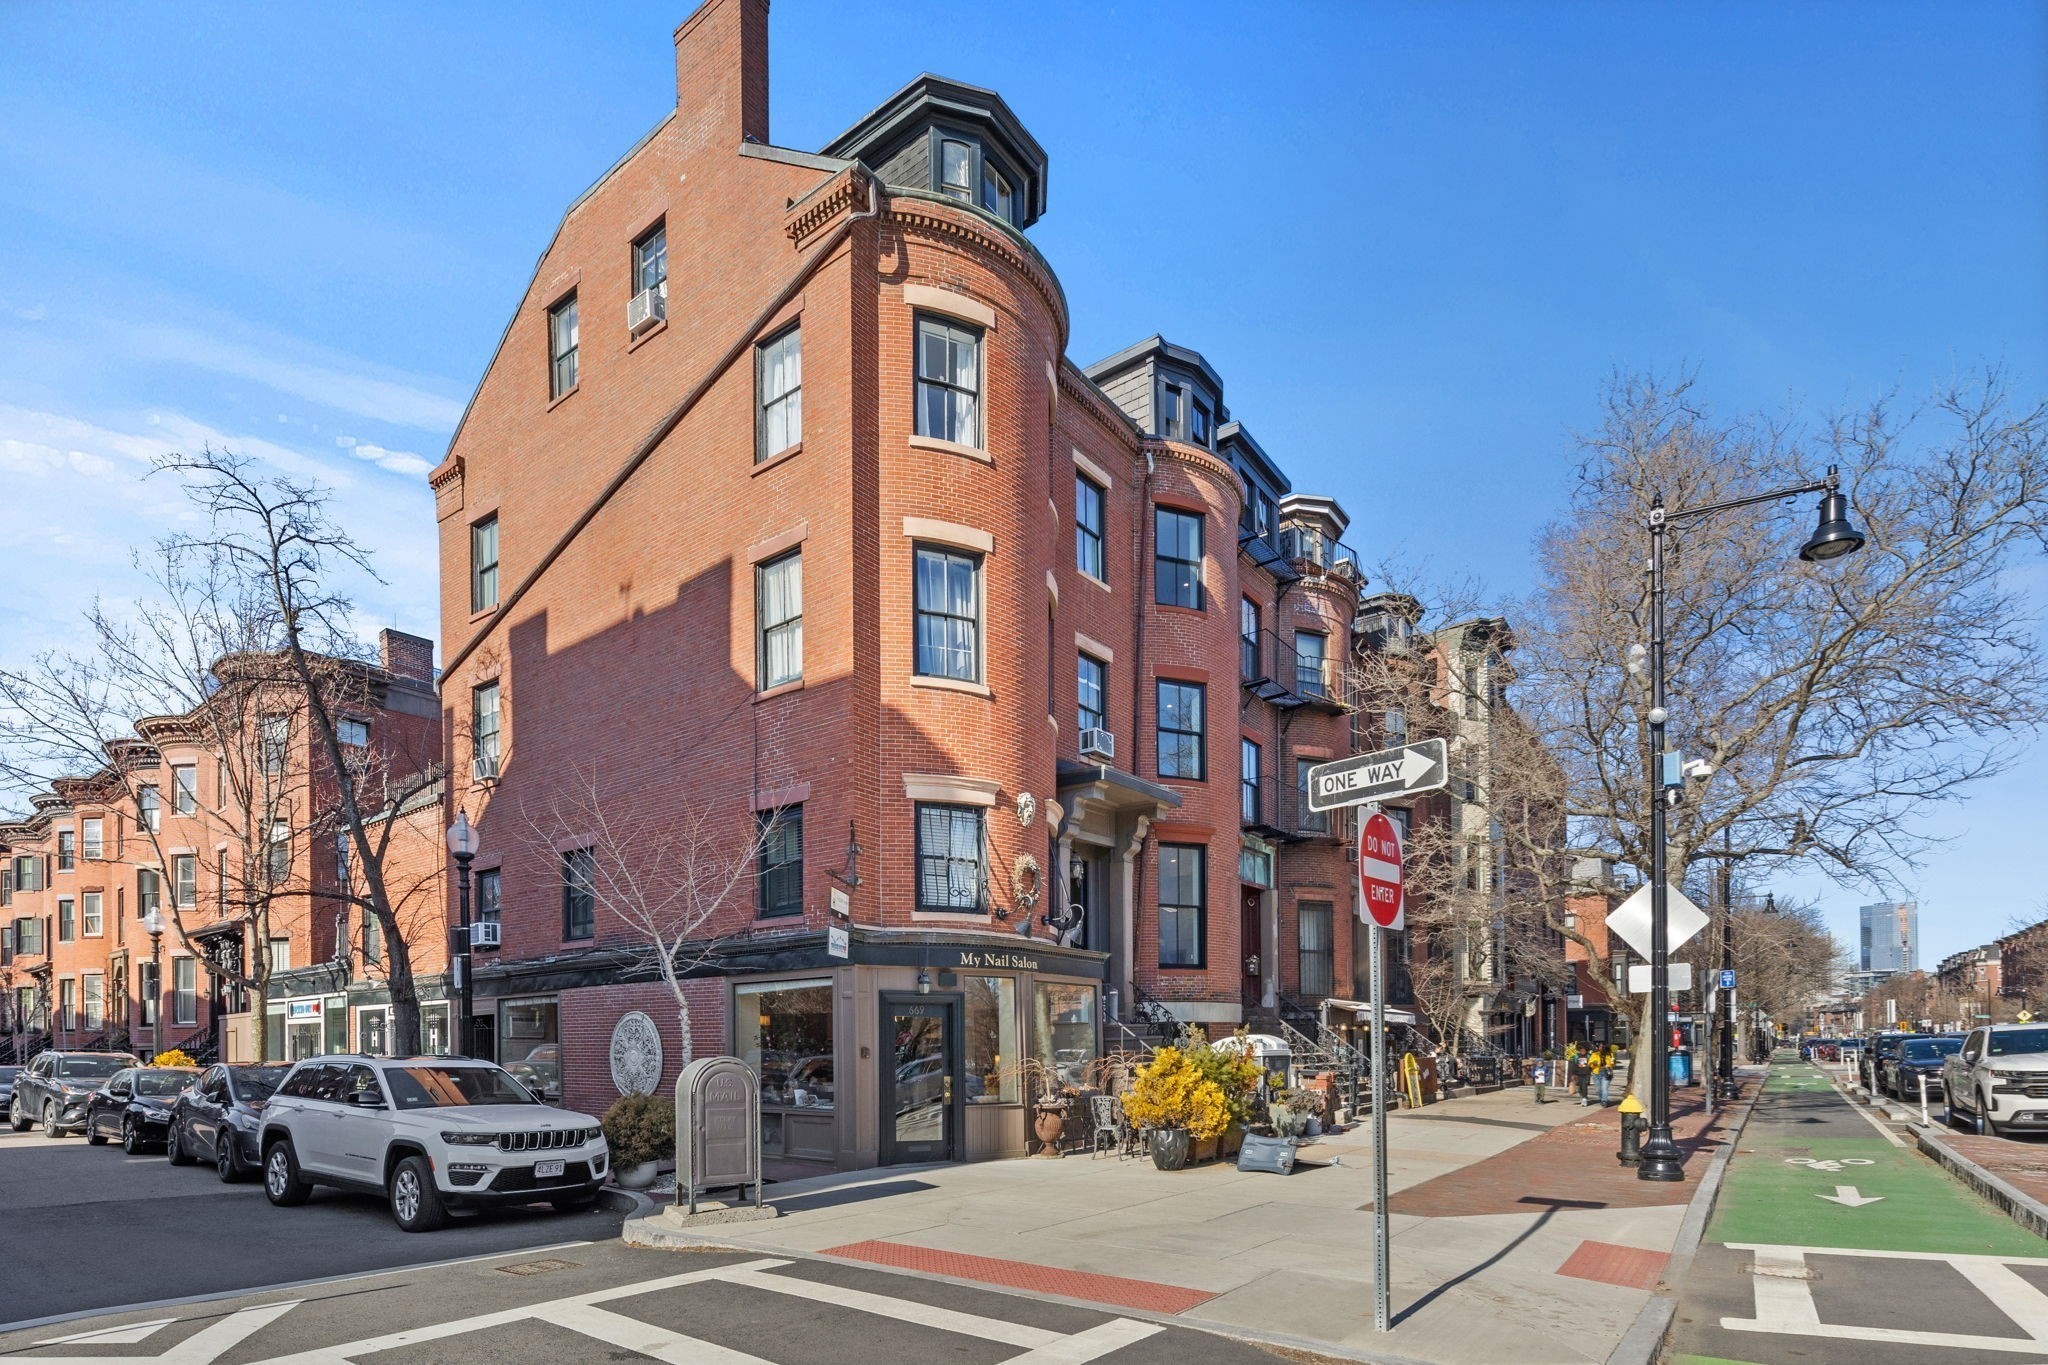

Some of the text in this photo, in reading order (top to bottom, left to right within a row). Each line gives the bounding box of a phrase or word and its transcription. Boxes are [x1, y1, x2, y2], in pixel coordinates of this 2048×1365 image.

[1324, 761, 1404, 793] ONE WAY
[1367, 835, 1395, 858] DO NOT
[1371, 884, 1395, 904] ENTER
[960, 952, 1038, 969] My Nail Salon
[909, 1004, 925, 1015] 669
[709, 1090, 740, 1102] MAIL
[555, 1164, 562, 1172] 91
